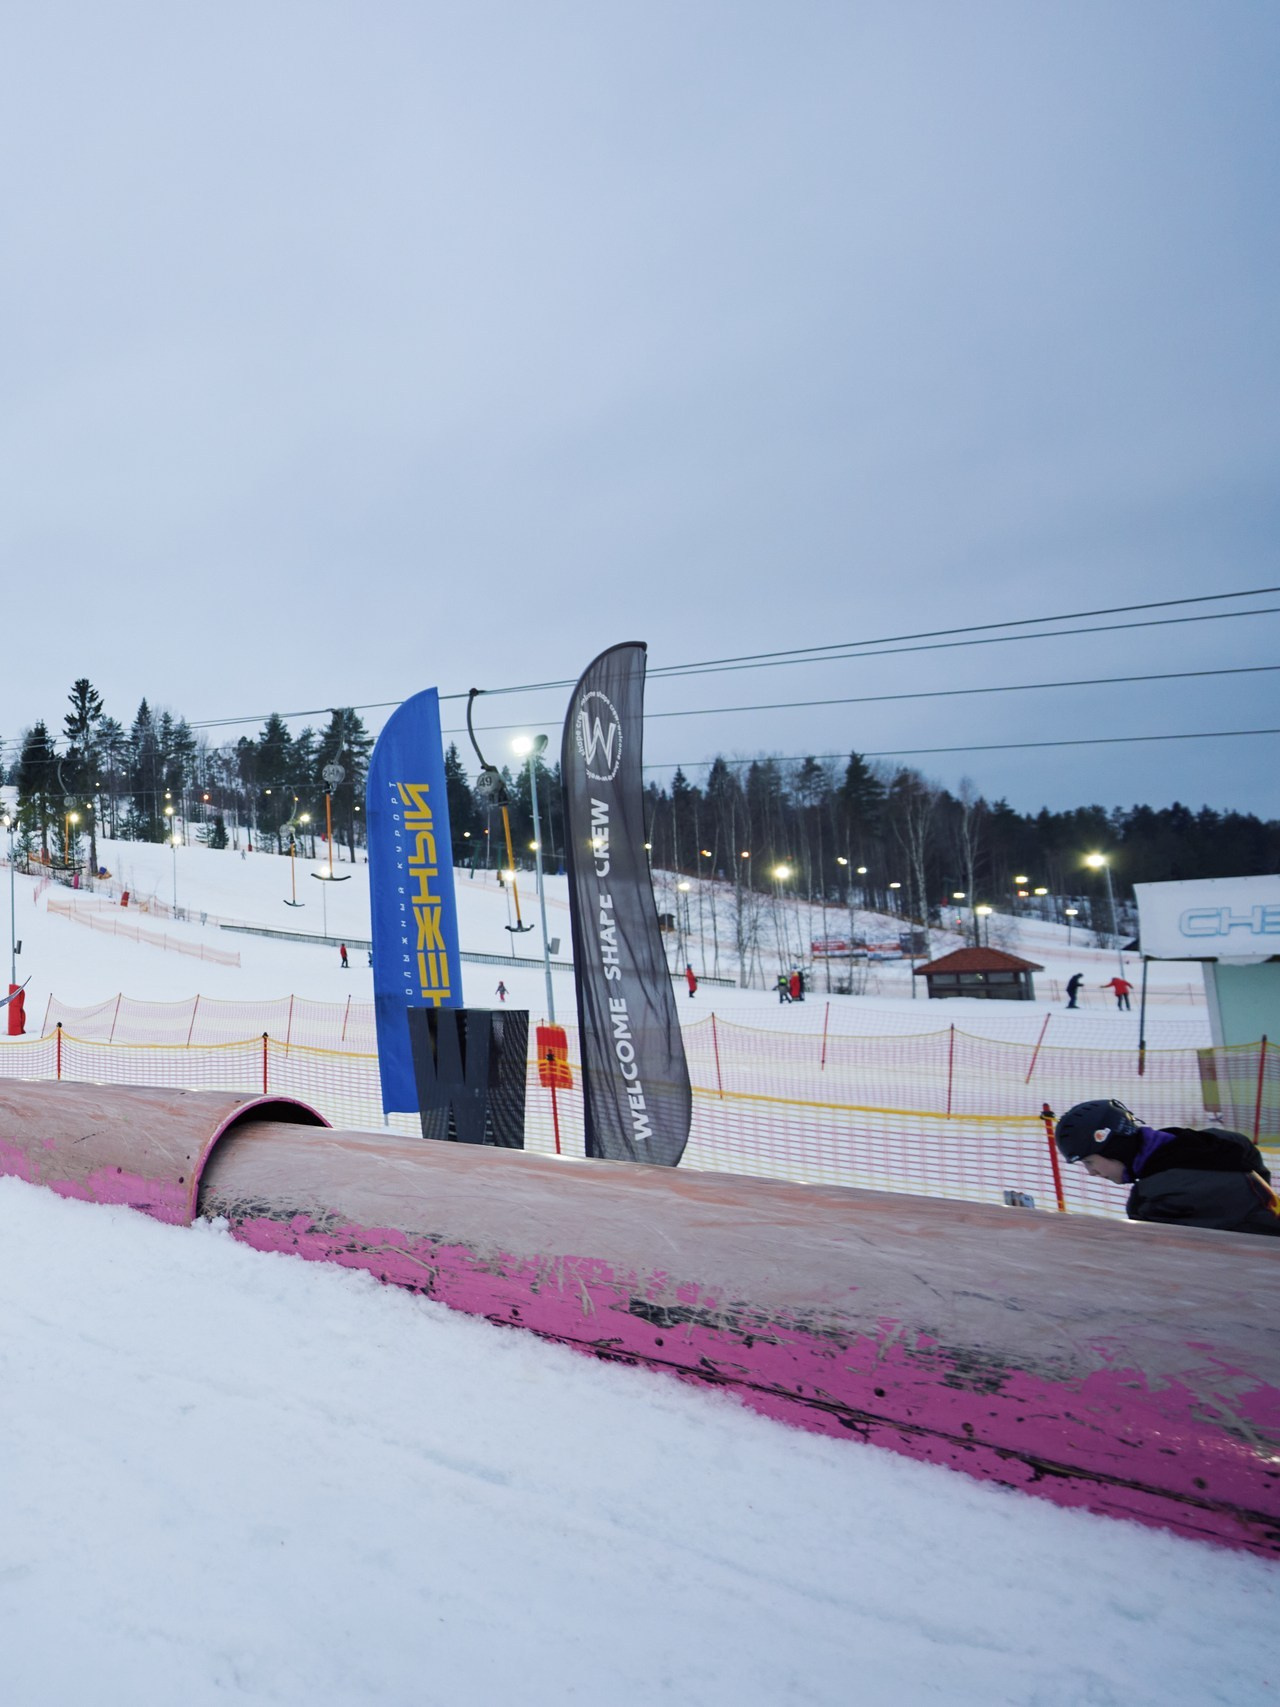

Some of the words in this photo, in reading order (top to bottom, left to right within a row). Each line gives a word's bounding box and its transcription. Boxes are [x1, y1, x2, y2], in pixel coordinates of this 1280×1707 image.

[389, 781, 404, 868] КУРОРТ
[479, 776, 492, 787] 49
[590, 798, 610, 877] CREW
[598, 894, 622, 981] SHAPE
[608, 997, 653, 1141] WELCOME
